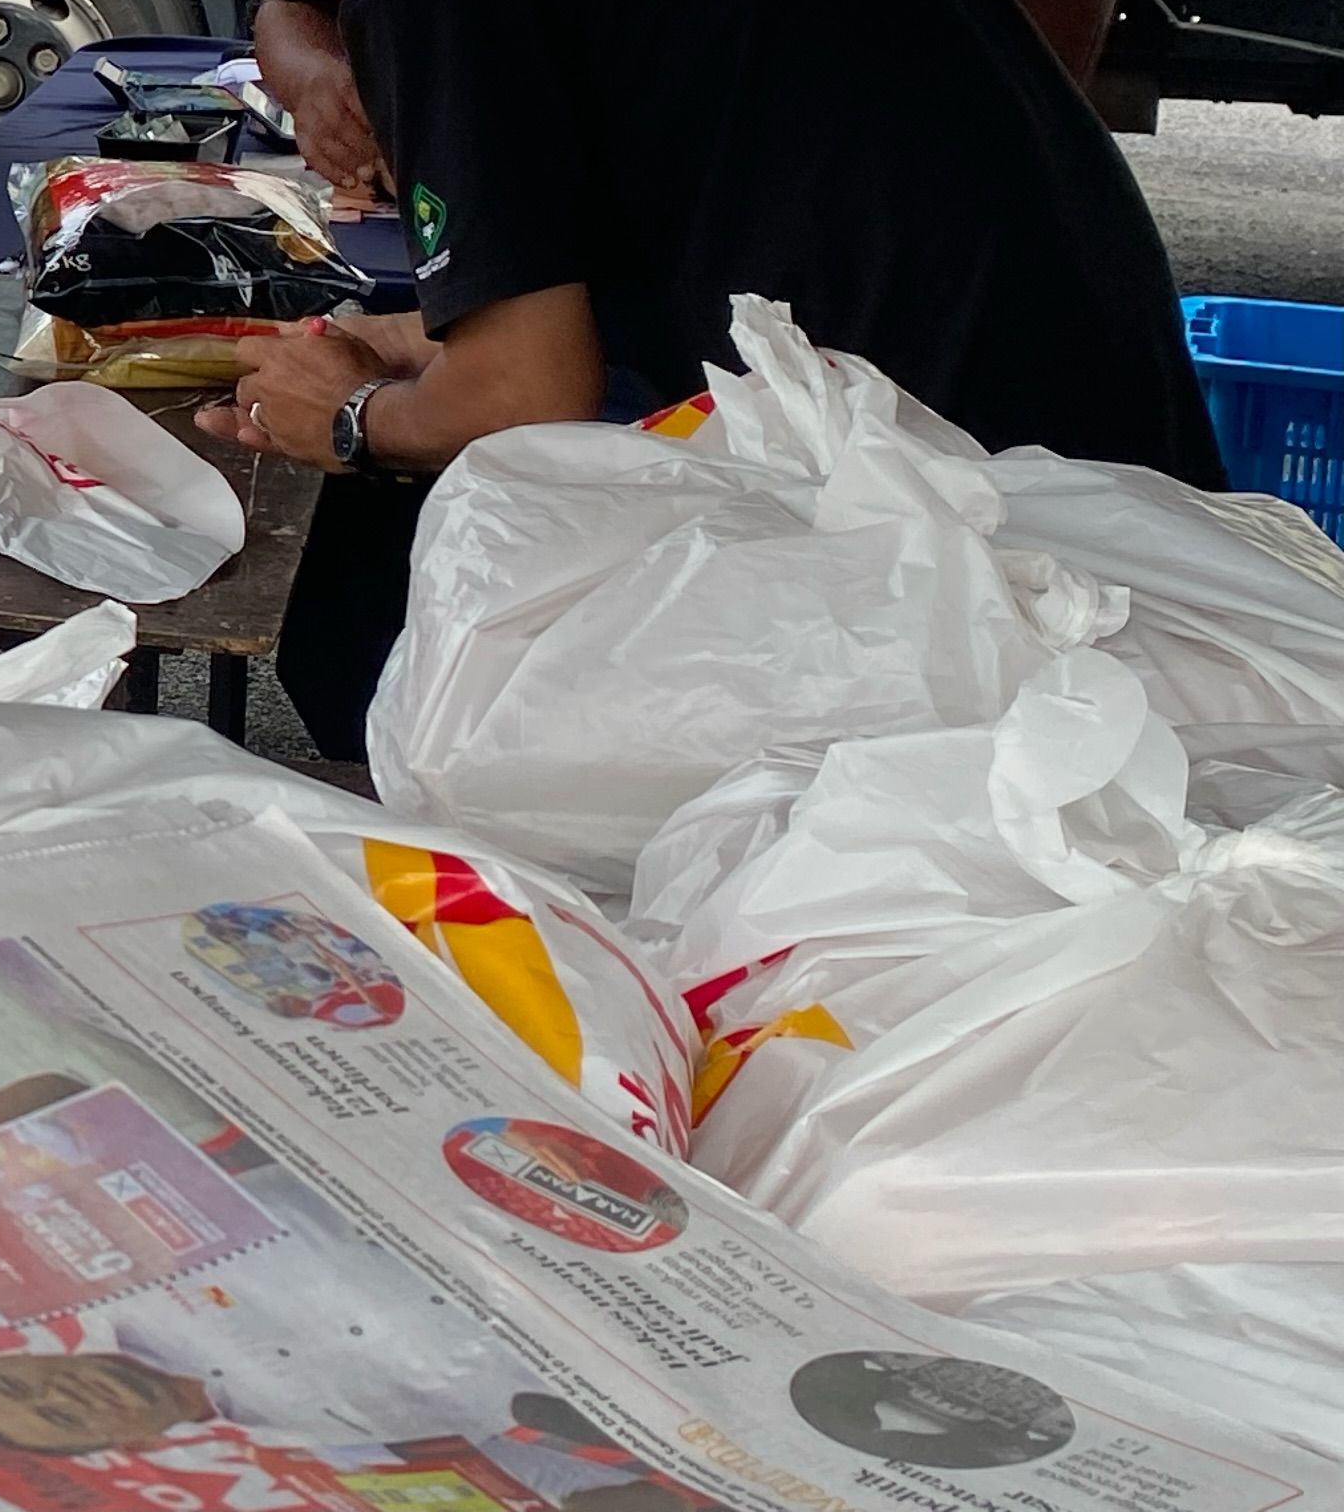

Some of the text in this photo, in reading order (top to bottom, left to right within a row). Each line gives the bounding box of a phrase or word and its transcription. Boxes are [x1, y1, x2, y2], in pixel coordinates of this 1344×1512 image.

[165, 970, 357, 1119] Rakaman kempen
[275, 1040, 379, 1117] 12 kerusi
[302, 1034, 412, 1114] parlimen
[564, 1260, 720, 1368] profesional
[605, 1309, 690, 1369] Bekas
[614, 1274, 752, 1364] jadi calon
